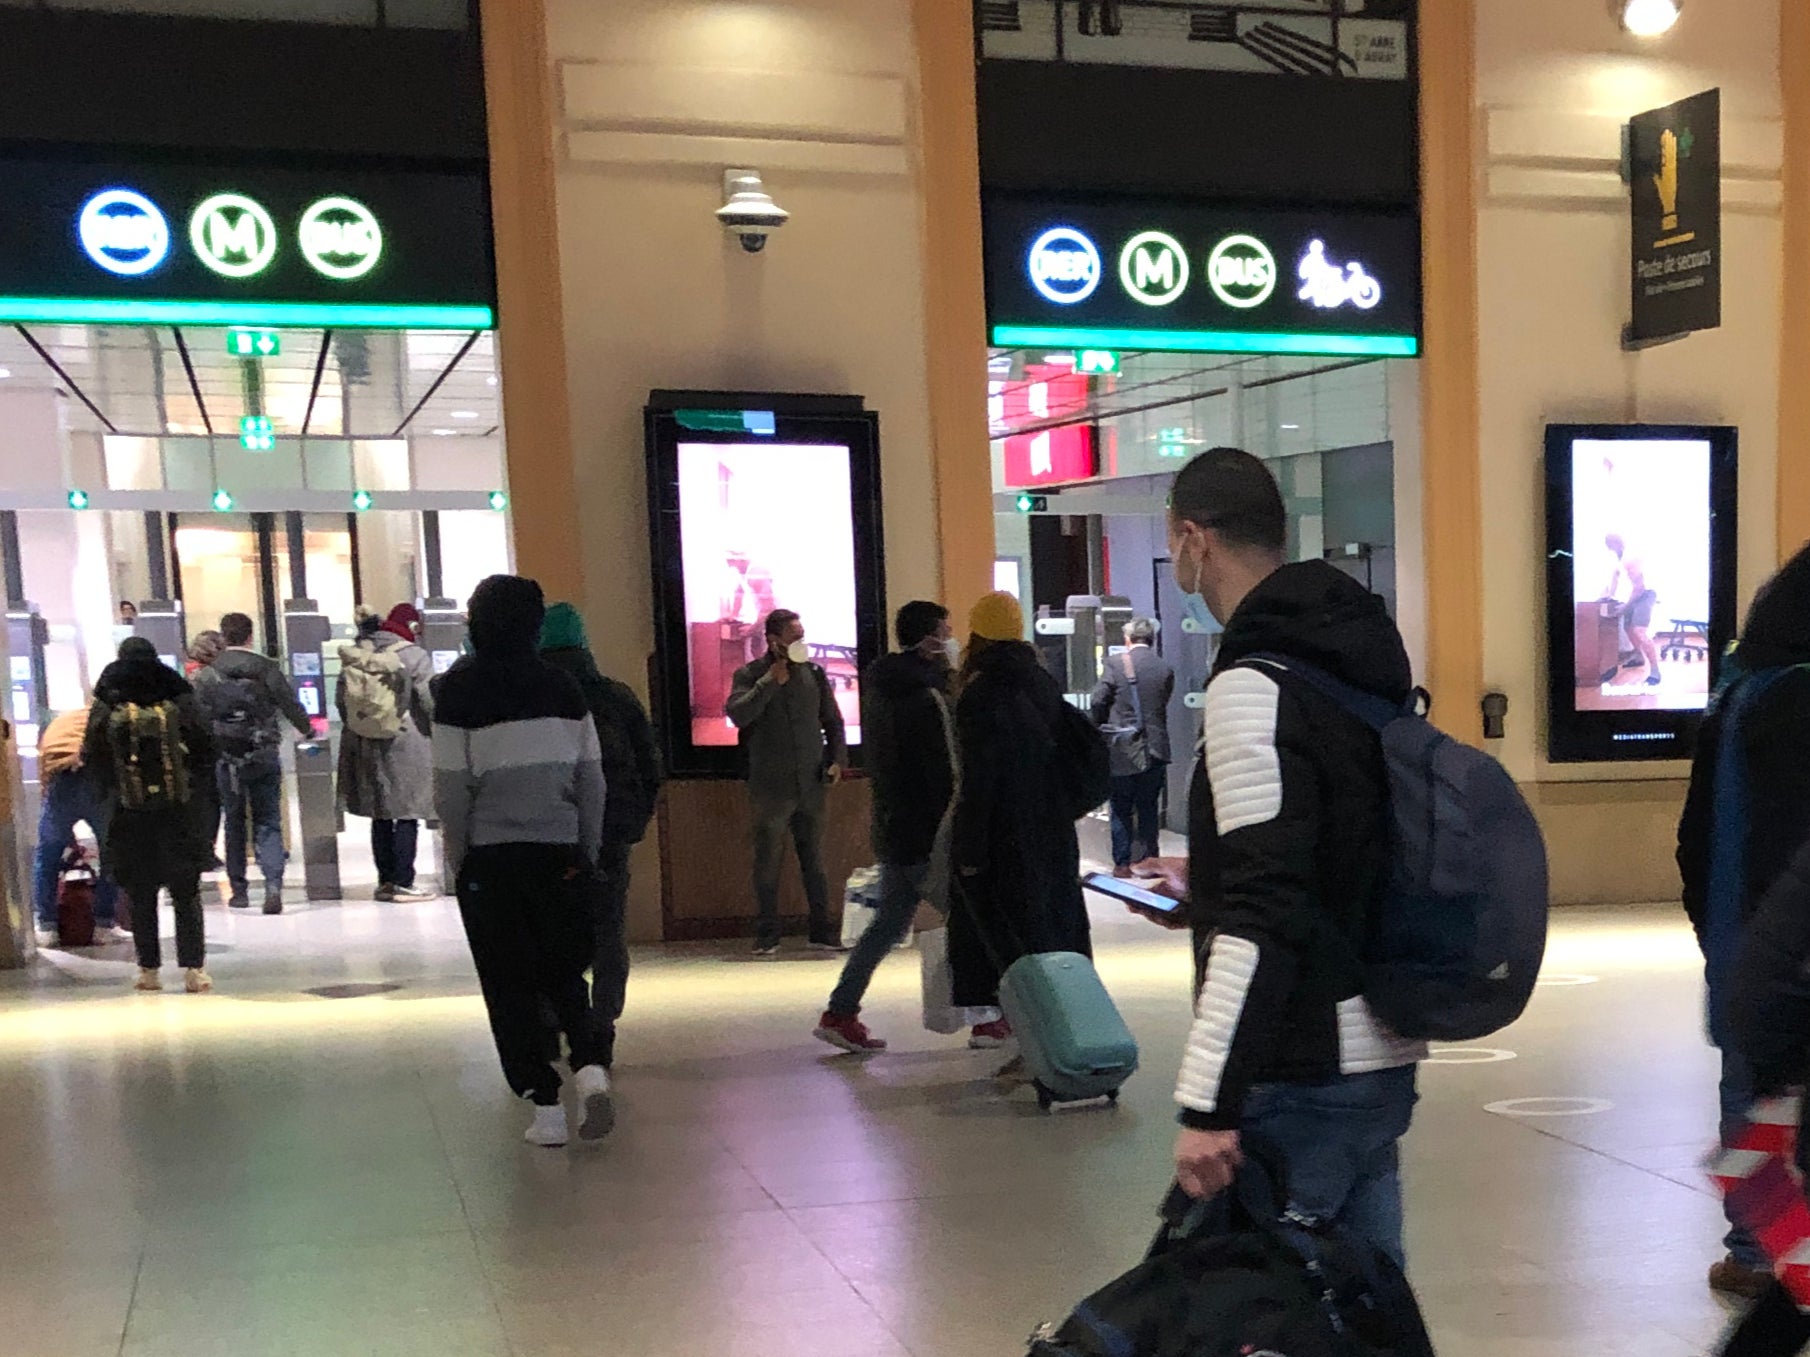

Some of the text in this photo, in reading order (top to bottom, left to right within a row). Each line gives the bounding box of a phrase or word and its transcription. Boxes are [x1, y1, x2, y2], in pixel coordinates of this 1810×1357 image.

[209, 210, 259, 260] M
[1136, 247, 1174, 290] M
[1217, 256, 1270, 286] BUS
[1638, 258, 1664, 278] Poste
[1677, 249, 1711, 271] secours
